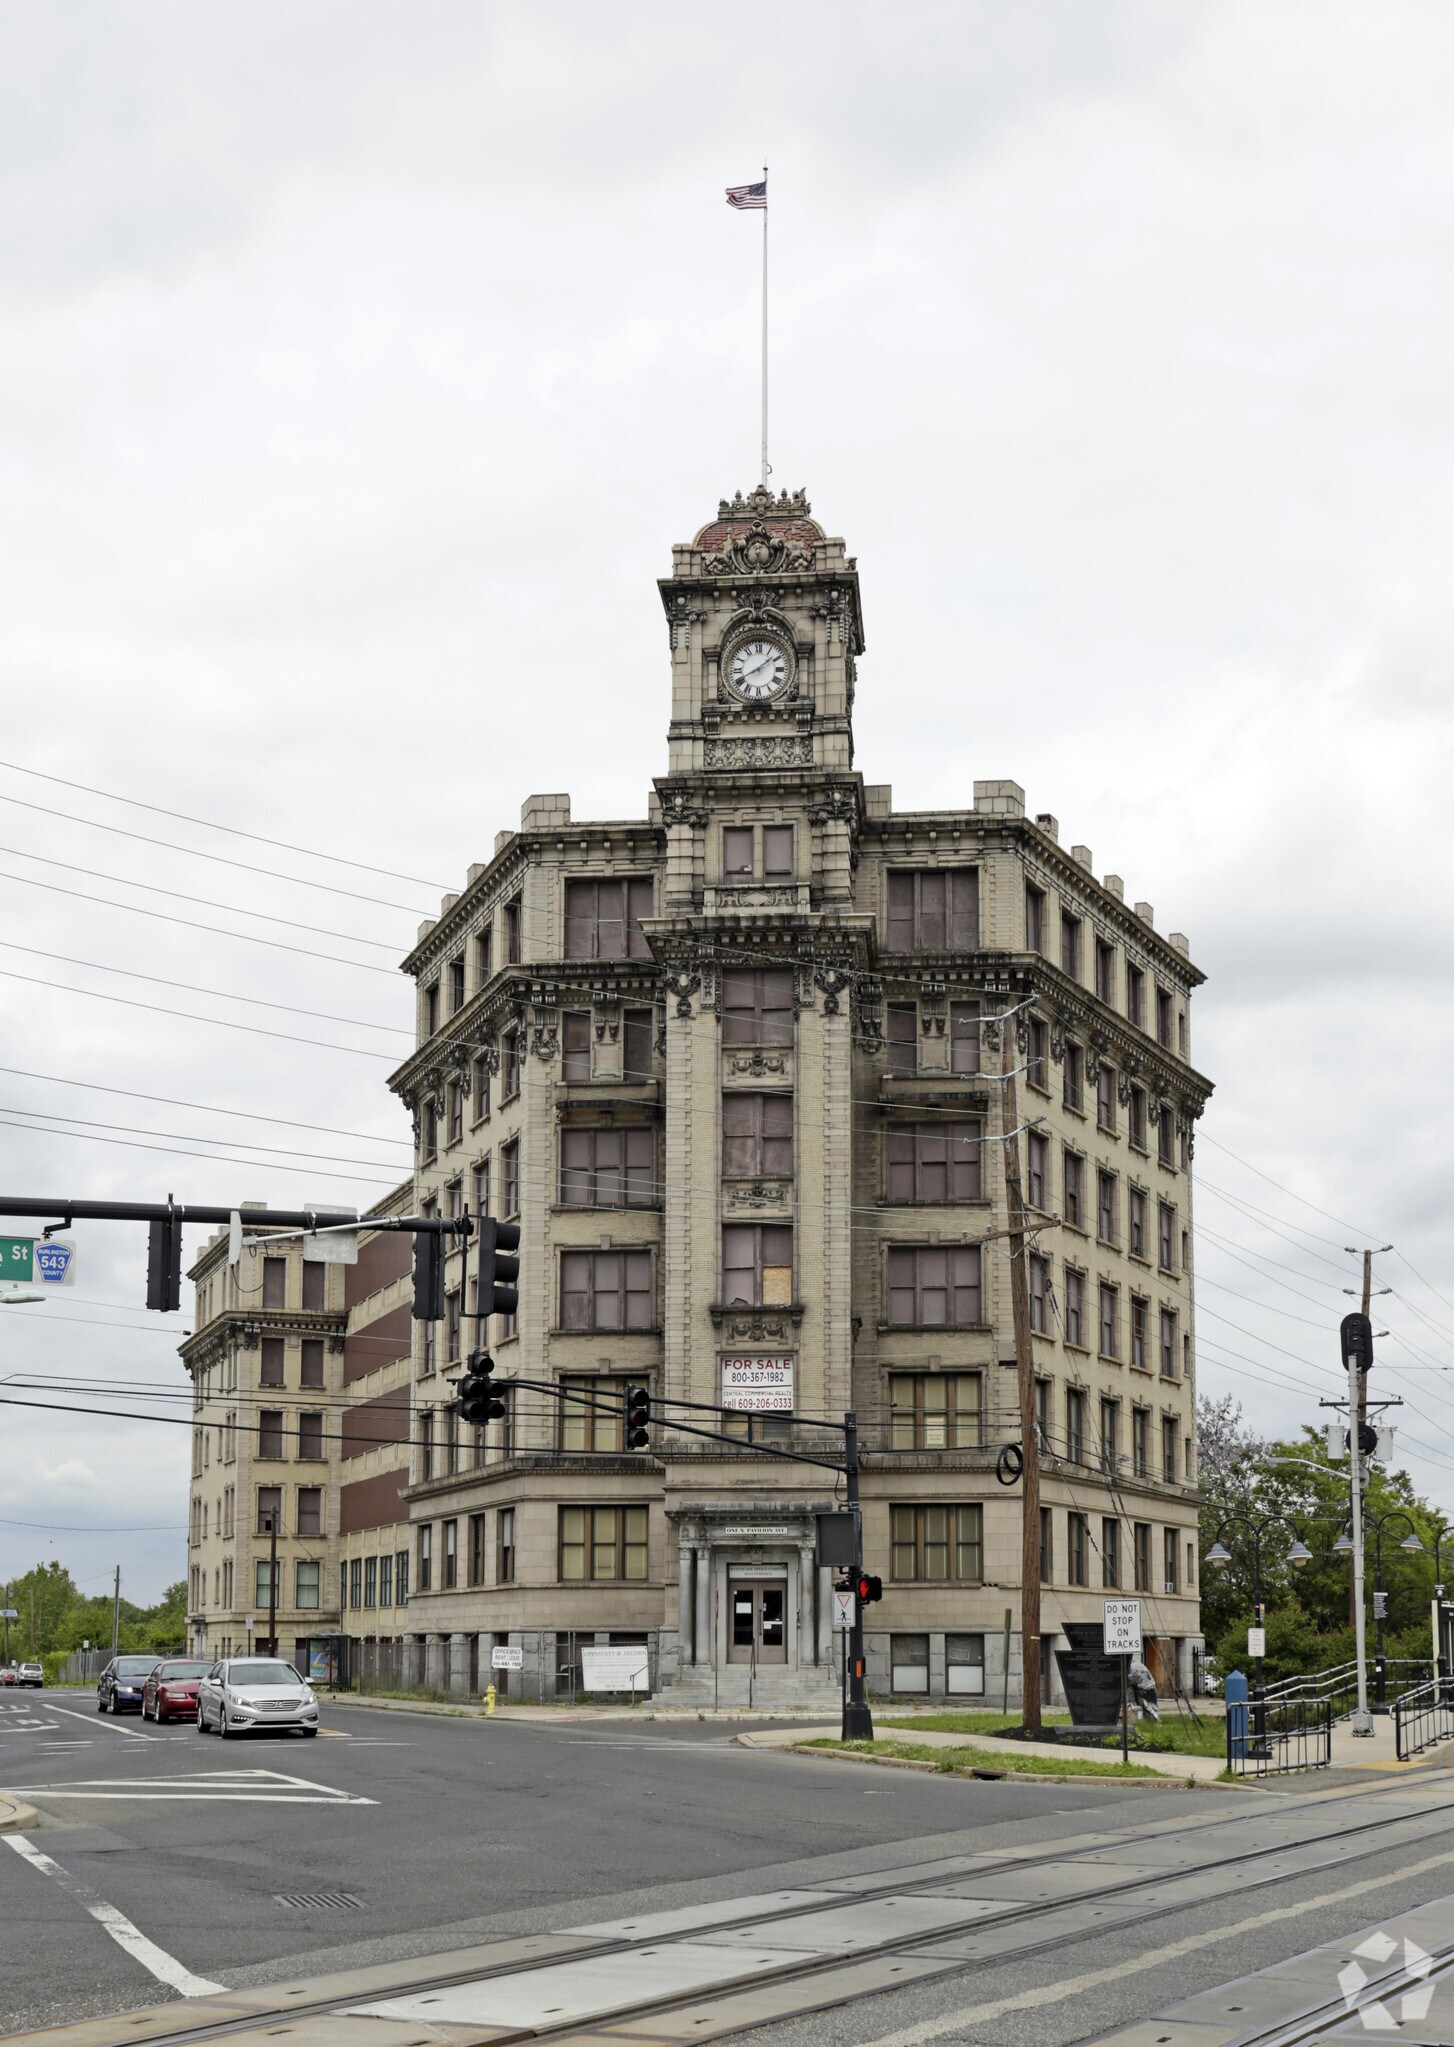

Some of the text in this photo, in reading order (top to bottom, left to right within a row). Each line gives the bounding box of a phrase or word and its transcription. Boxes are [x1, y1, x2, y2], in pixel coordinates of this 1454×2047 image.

[12, 1245, 28, 1260] St
[41, 1256, 65, 1269] 543
[724, 1359, 791, 1370] FOR SALE
[723, 1398, 736, 1408] cell
[1107, 1604, 1137, 1613] DO NOT
[1112, 1617, 1133, 1625] STOP
[1117, 1628, 1129, 1636] ON
[1107, 1640, 1140, 1649] TRACKS
